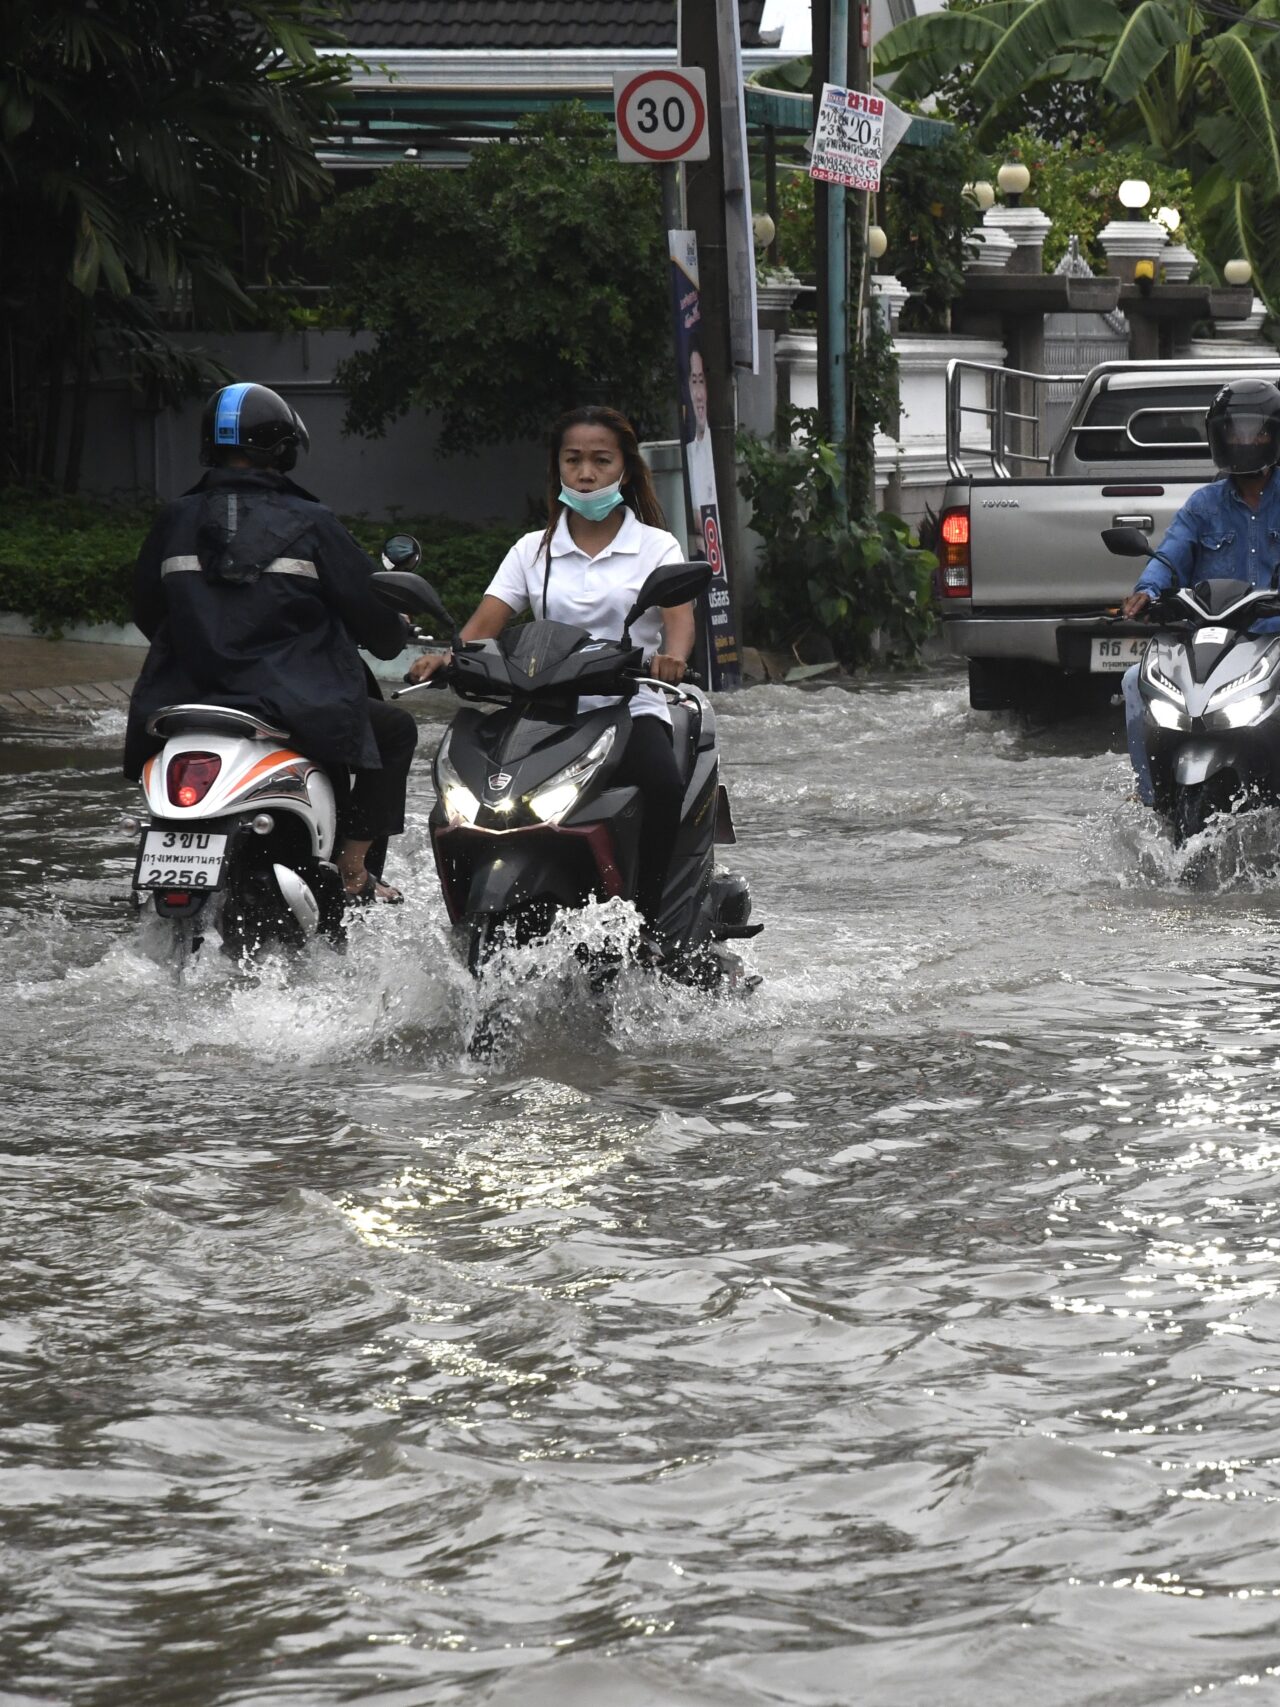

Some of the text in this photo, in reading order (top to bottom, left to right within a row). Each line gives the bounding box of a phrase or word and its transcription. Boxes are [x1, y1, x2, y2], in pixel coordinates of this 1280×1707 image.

[848, 92, 884, 116] ขาย
[637, 96, 685, 133] 30
[982, 499, 1020, 508] TOYOTA
[704, 516, 722, 576] 8
[143, 853, 222, 866] กรุงเทพมหานคร
[147, 869, 208, 885] 2256
